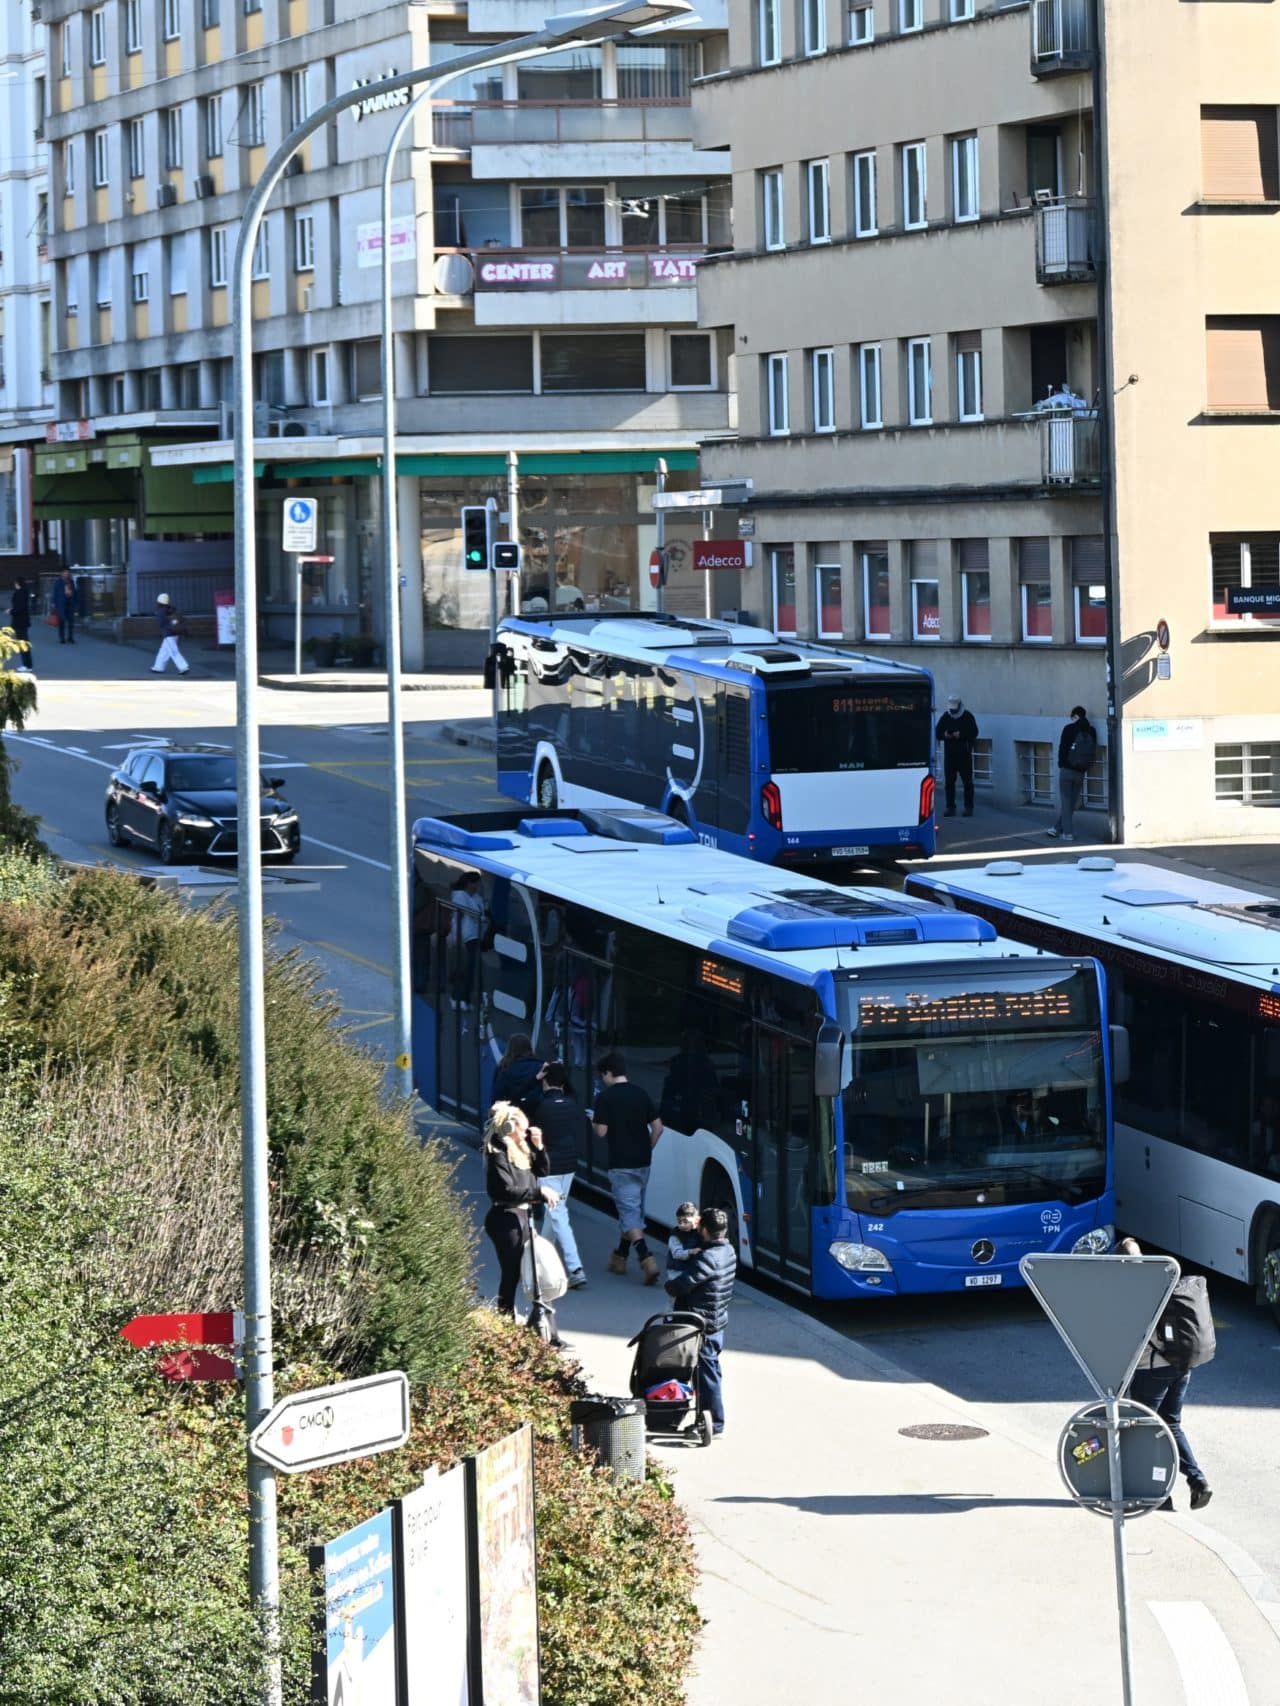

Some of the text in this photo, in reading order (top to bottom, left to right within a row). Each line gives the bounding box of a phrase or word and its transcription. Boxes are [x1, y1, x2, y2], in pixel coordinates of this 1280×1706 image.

[481, 263, 553, 282] CENTER
[587, 261, 627, 279] ART
[698, 554, 742, 568] Adecco
[1233, 596, 1265, 604] BANQUE
[867, 1223, 884, 1232] 242
[1042, 1225, 1061, 1234] TPN
